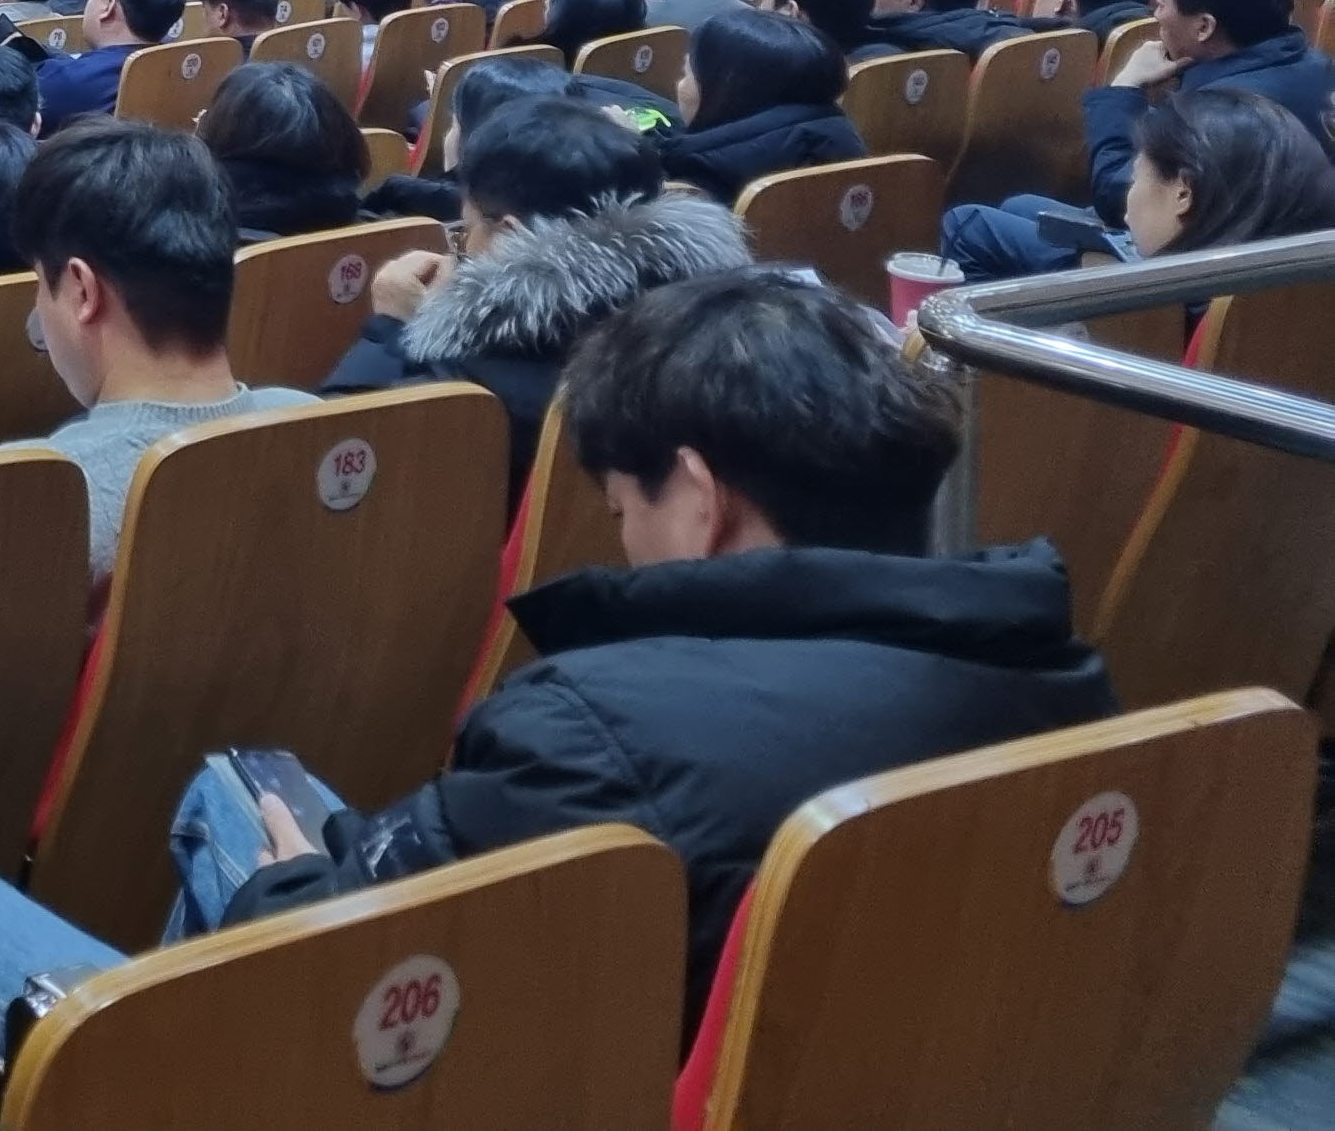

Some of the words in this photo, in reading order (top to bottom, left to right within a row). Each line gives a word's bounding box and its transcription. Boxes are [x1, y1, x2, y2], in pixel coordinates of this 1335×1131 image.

[334, 449, 367, 475] 183
[1075, 807, 1125, 856] 205
[378, 972, 443, 1032] 206
